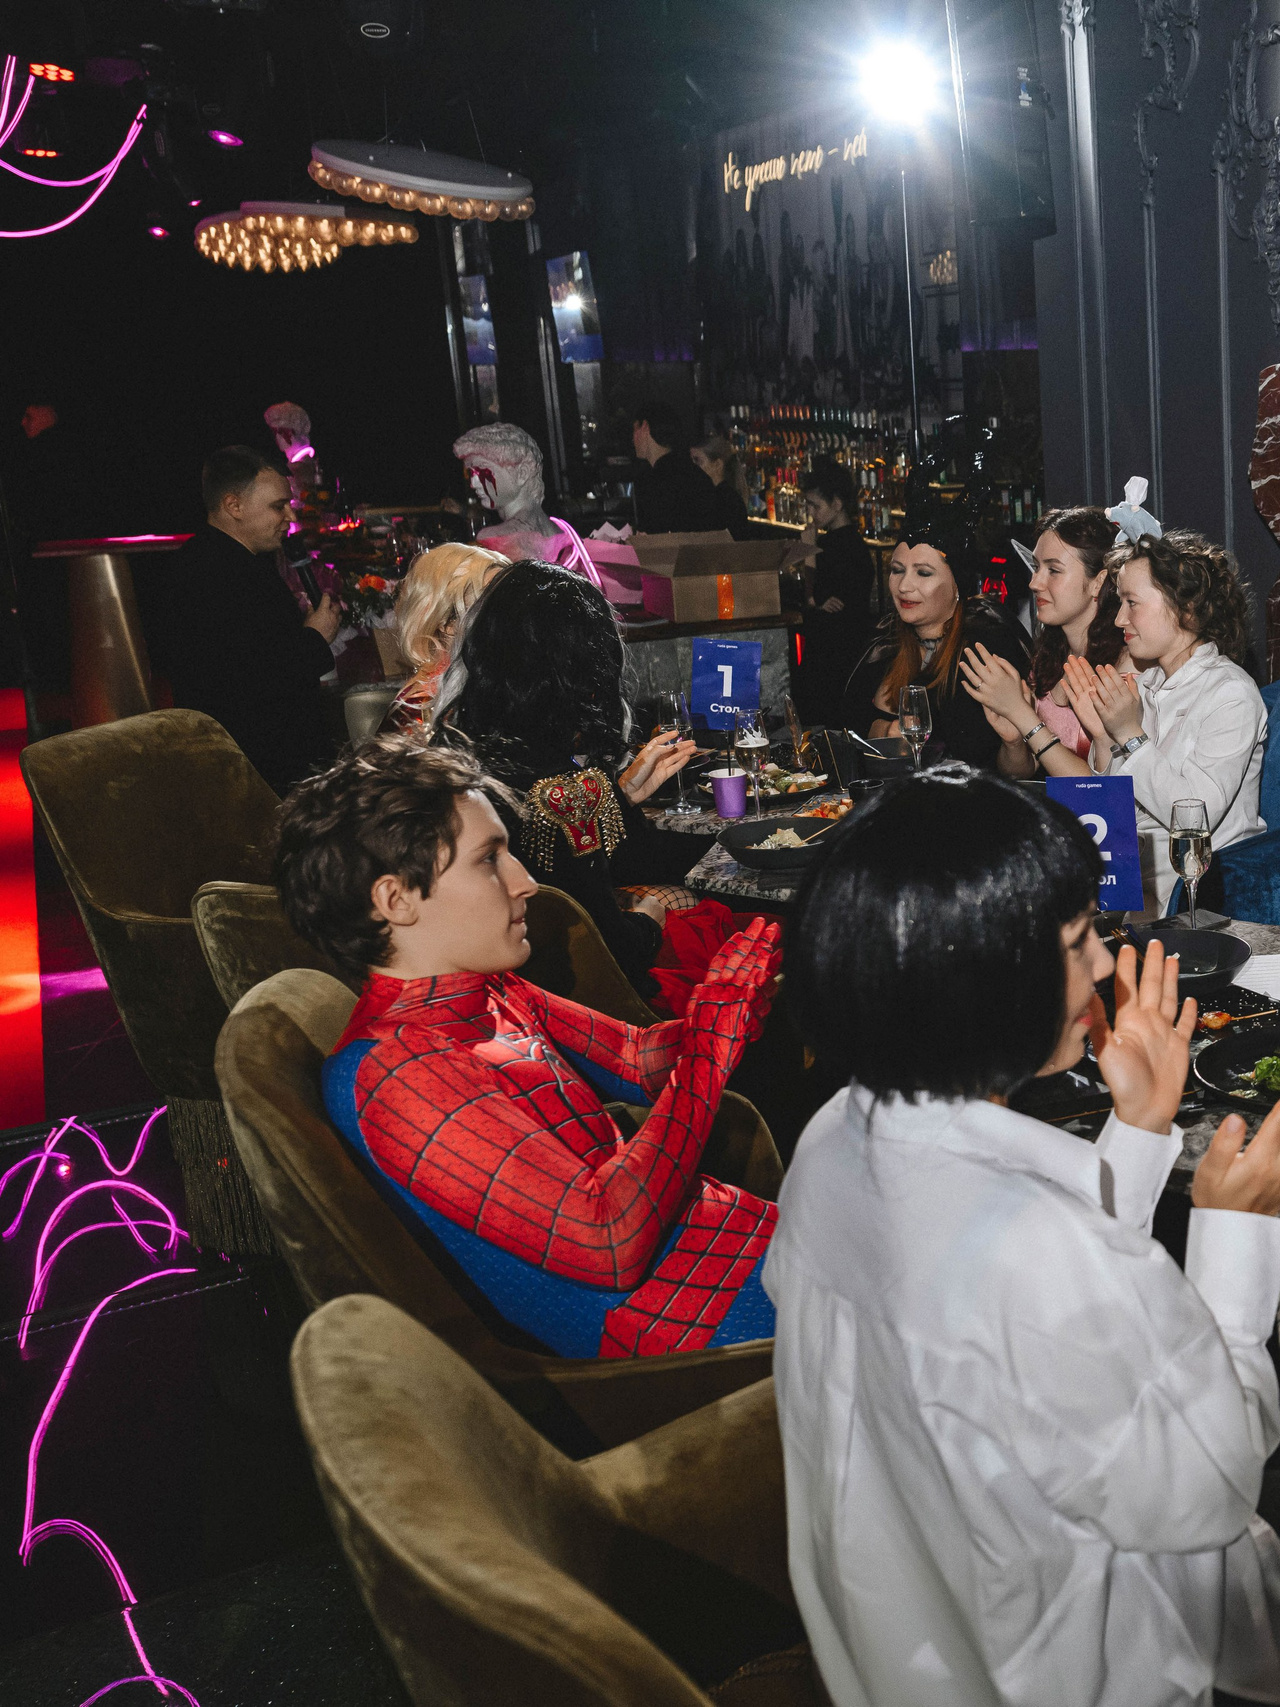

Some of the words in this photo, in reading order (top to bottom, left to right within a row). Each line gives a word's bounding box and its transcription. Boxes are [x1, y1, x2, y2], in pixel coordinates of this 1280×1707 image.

[717, 664, 733, 698] 1
[710, 703, 740, 714] Стол
[1098, 874, 1117, 886] ол
